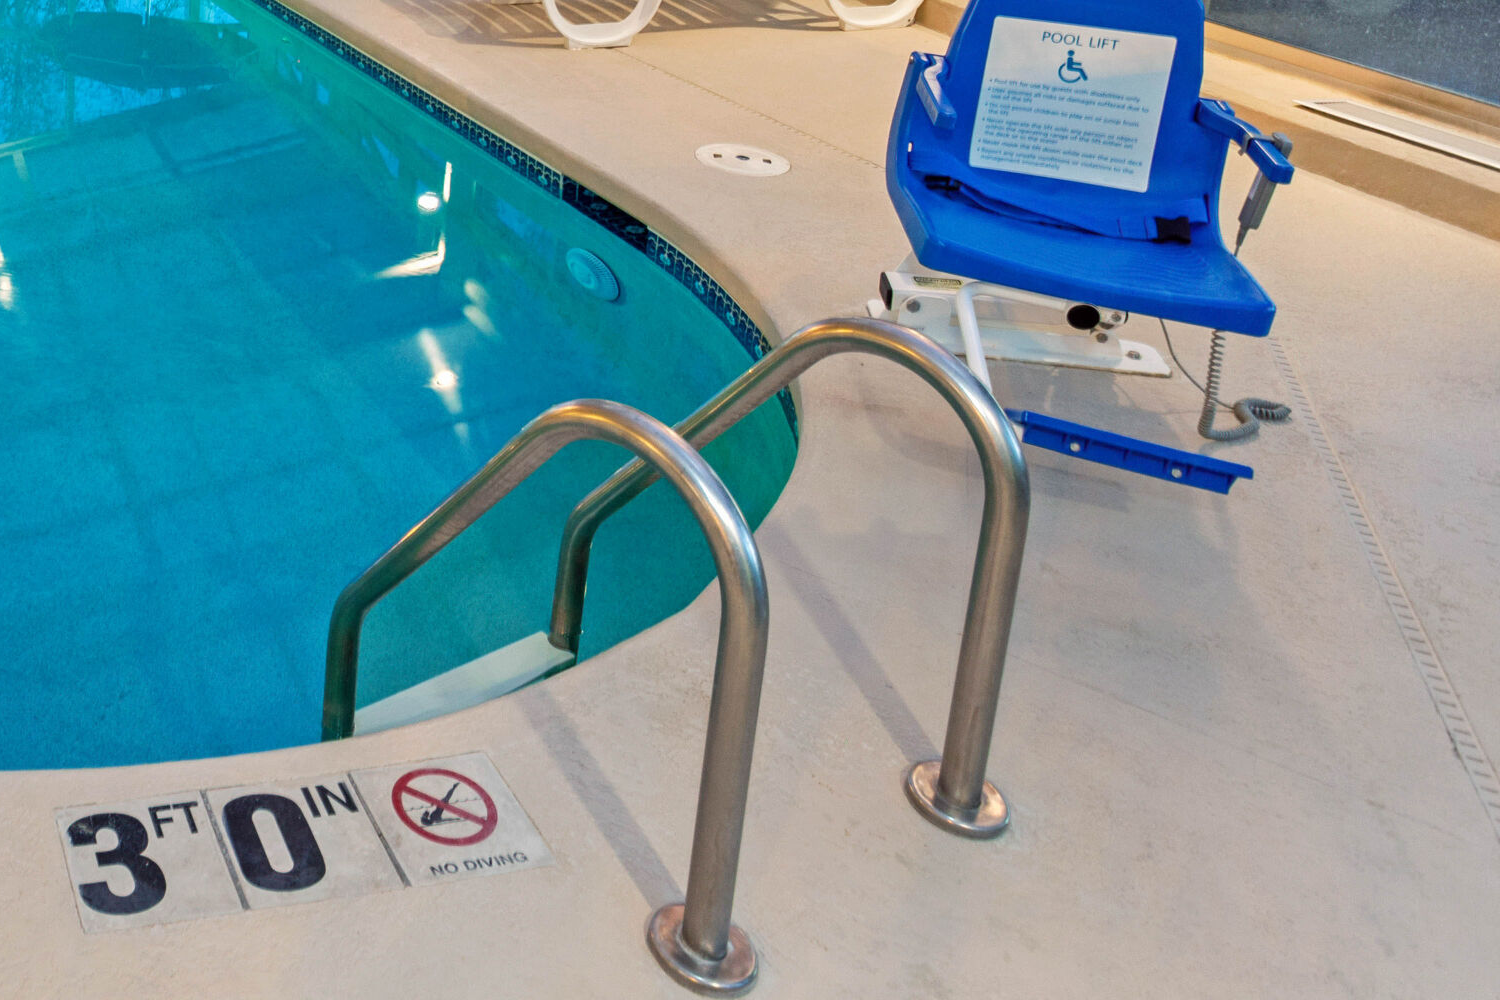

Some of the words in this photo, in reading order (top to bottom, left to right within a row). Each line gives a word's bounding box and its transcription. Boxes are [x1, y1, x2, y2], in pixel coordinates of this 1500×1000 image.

[1042, 31, 1082, 46] POOL
[1089, 37, 1120, 50] LIFT
[68, 812, 167, 916] 3
[148, 801, 200, 840] FT
[226, 792, 326, 892] 0
[303, 781, 360, 818] IN
[430, 861, 458, 876] NO
[463, 850, 529, 873] DIVING
